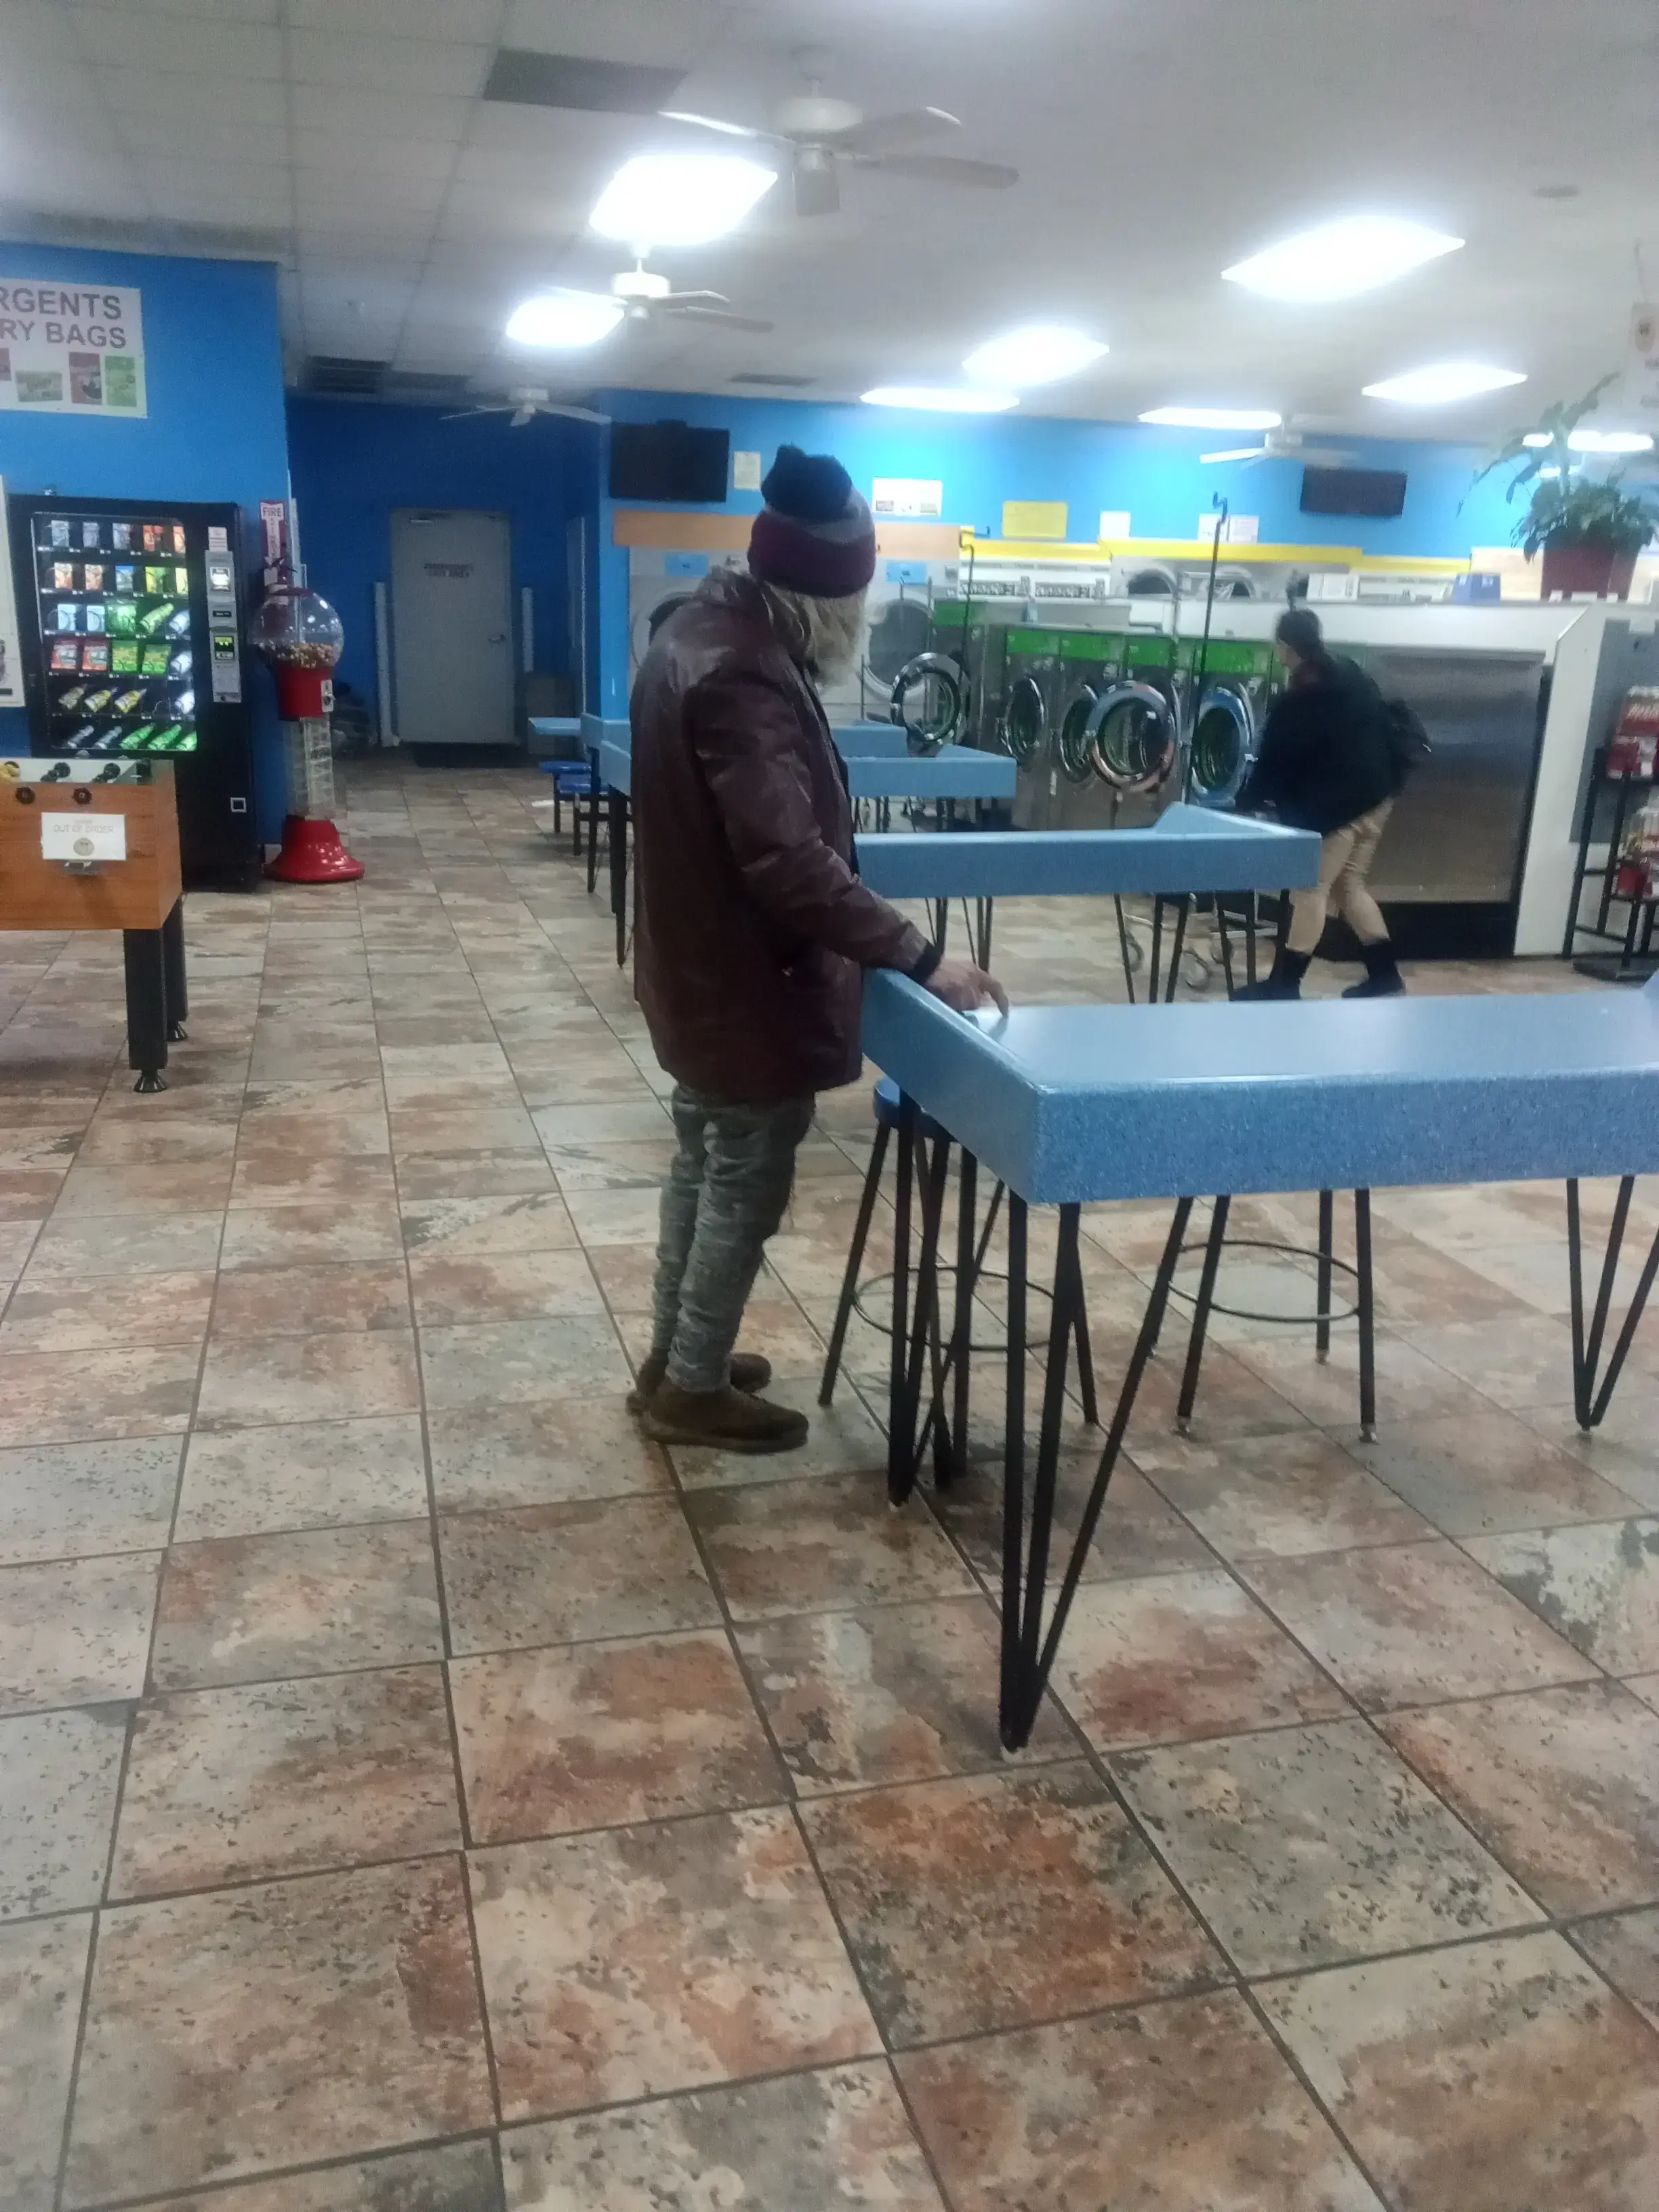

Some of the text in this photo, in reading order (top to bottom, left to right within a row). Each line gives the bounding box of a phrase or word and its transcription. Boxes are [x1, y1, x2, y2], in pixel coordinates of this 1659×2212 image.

[0, 318, 127, 349] RY BAGS
[263, 507, 281, 517] FIRE
[54, 824, 70, 833] OUT
